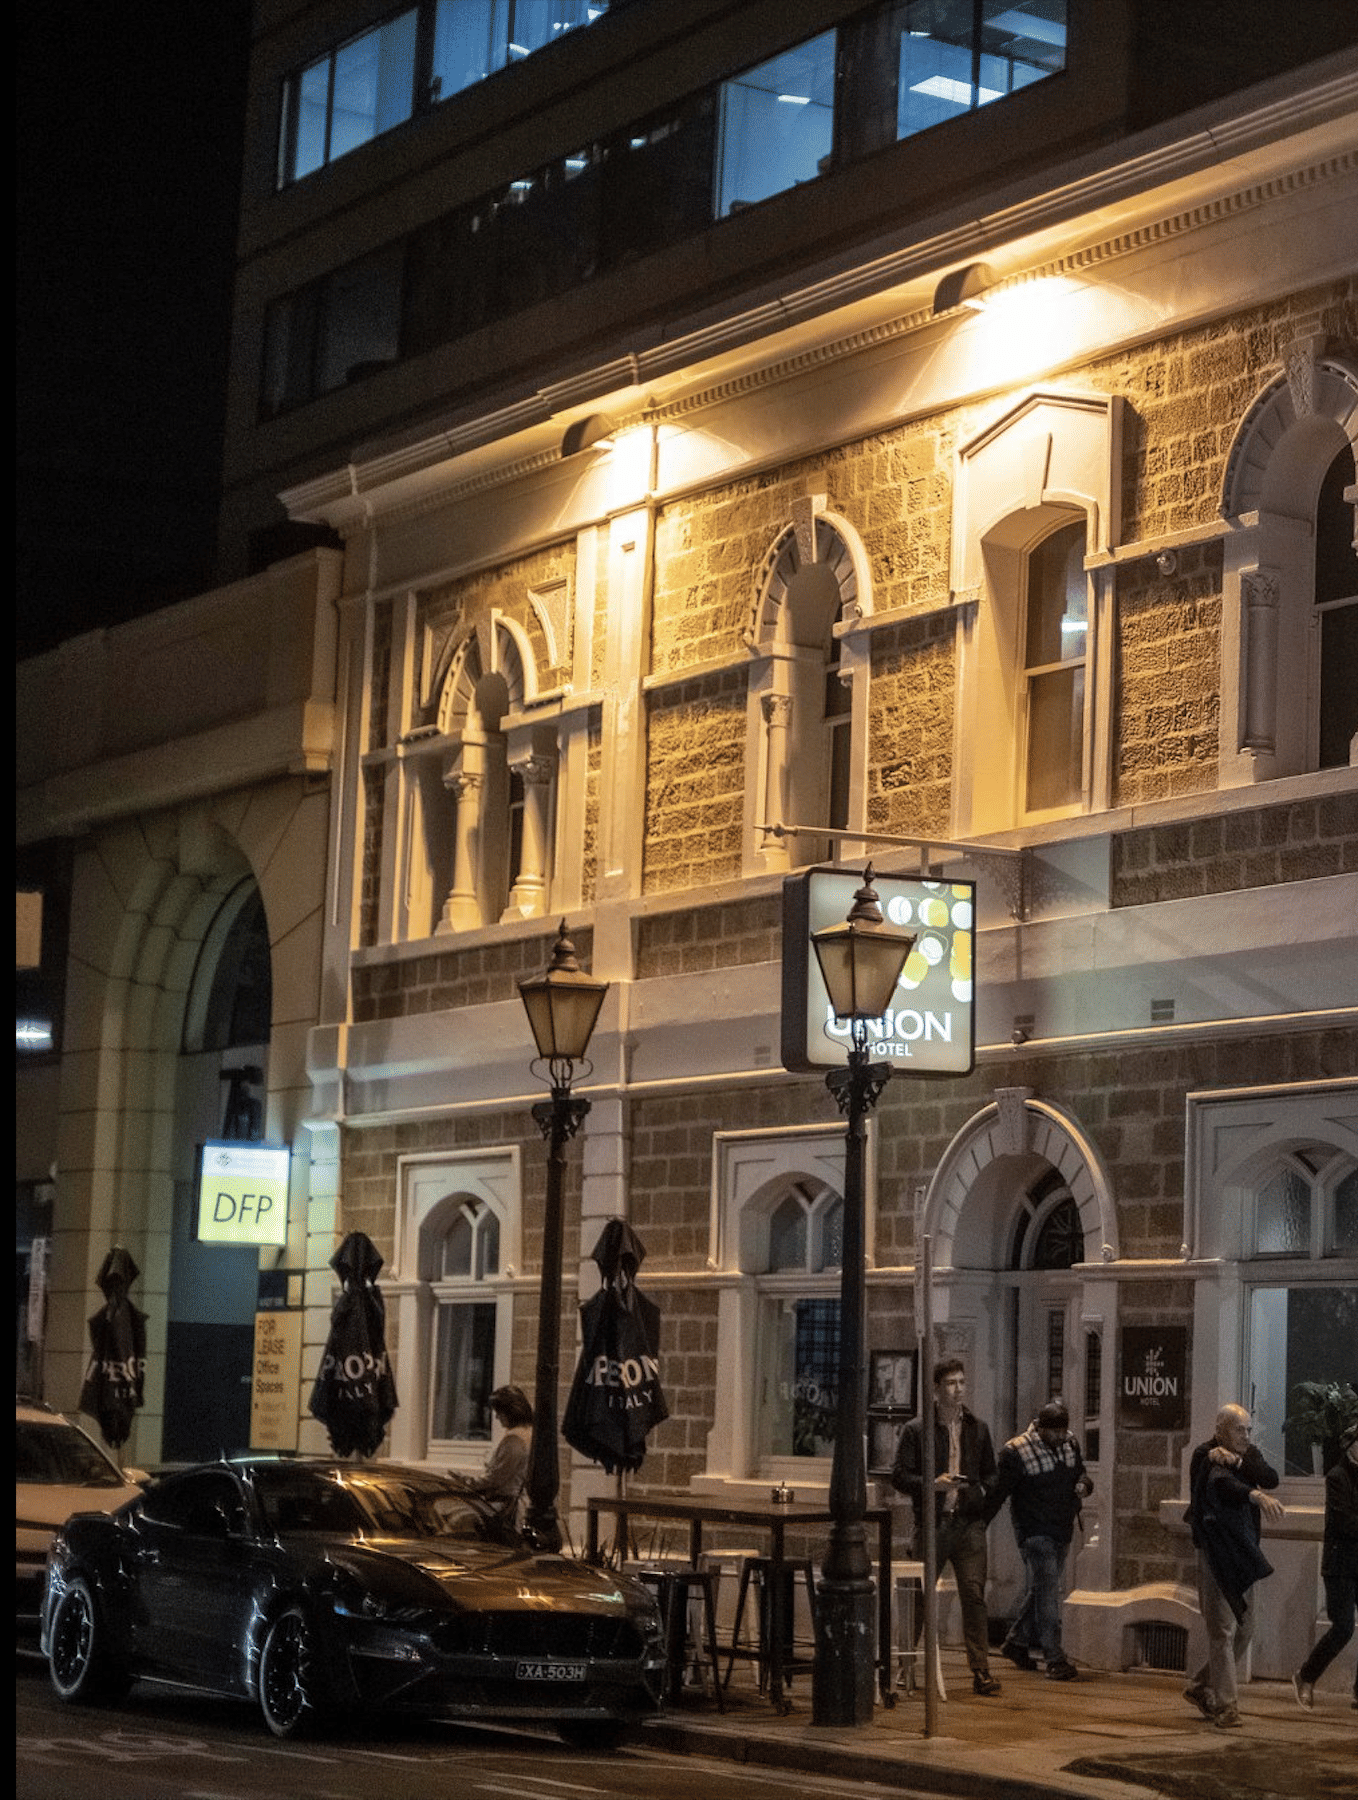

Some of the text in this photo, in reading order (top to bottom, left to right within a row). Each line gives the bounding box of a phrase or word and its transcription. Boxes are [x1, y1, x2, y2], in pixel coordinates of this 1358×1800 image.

[827, 1004, 952, 1042] UNION
[213, 1192, 273, 1224] DFP
[258, 1319, 276, 1335] FOR
[257, 1339, 285, 1355] LEASE
[1125, 1376, 1177, 1396] UNION
